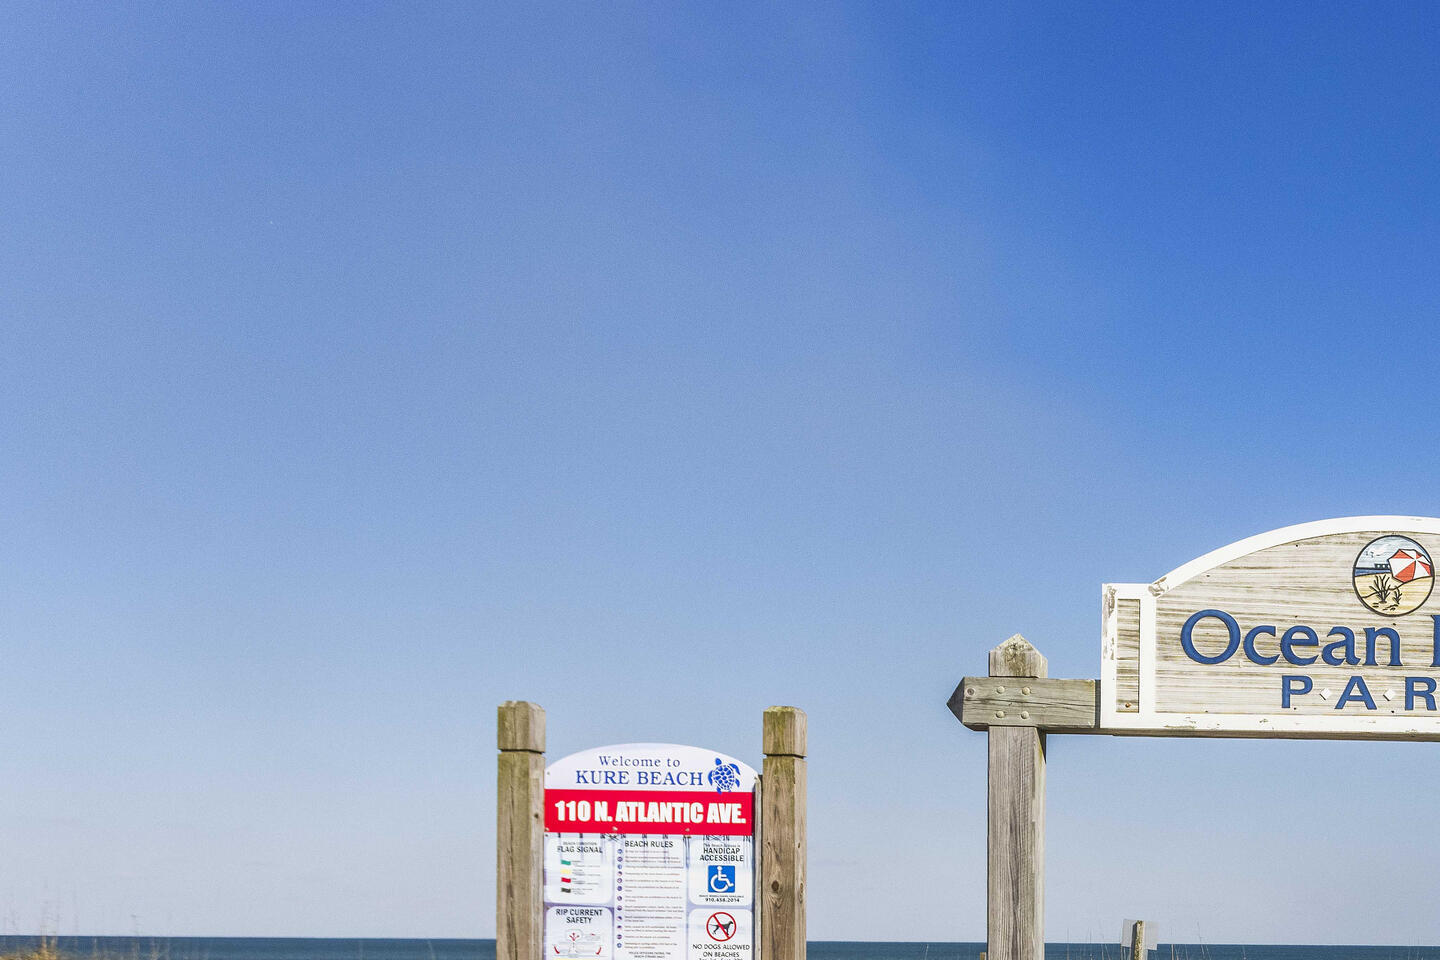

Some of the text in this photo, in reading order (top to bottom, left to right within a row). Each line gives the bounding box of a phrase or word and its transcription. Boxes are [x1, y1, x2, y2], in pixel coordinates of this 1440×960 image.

[1180, 609, 1403, 666] Ocean
[599, 756, 681, 767] Welcome to
[576, 770, 703, 786] KURE BEACH
[555, 800, 746, 824] 110 N. ATLANTIC AVE.
[625, 840, 648, 848] BEACH
[576, 846, 603, 854] SIGNAL
[703, 847, 741, 855] HANDICAP
[700, 854, 744, 862] ACCESSIBLE
[556, 908, 603, 917] RIP CURRENT
[566, 916, 592, 924] SAFETY
